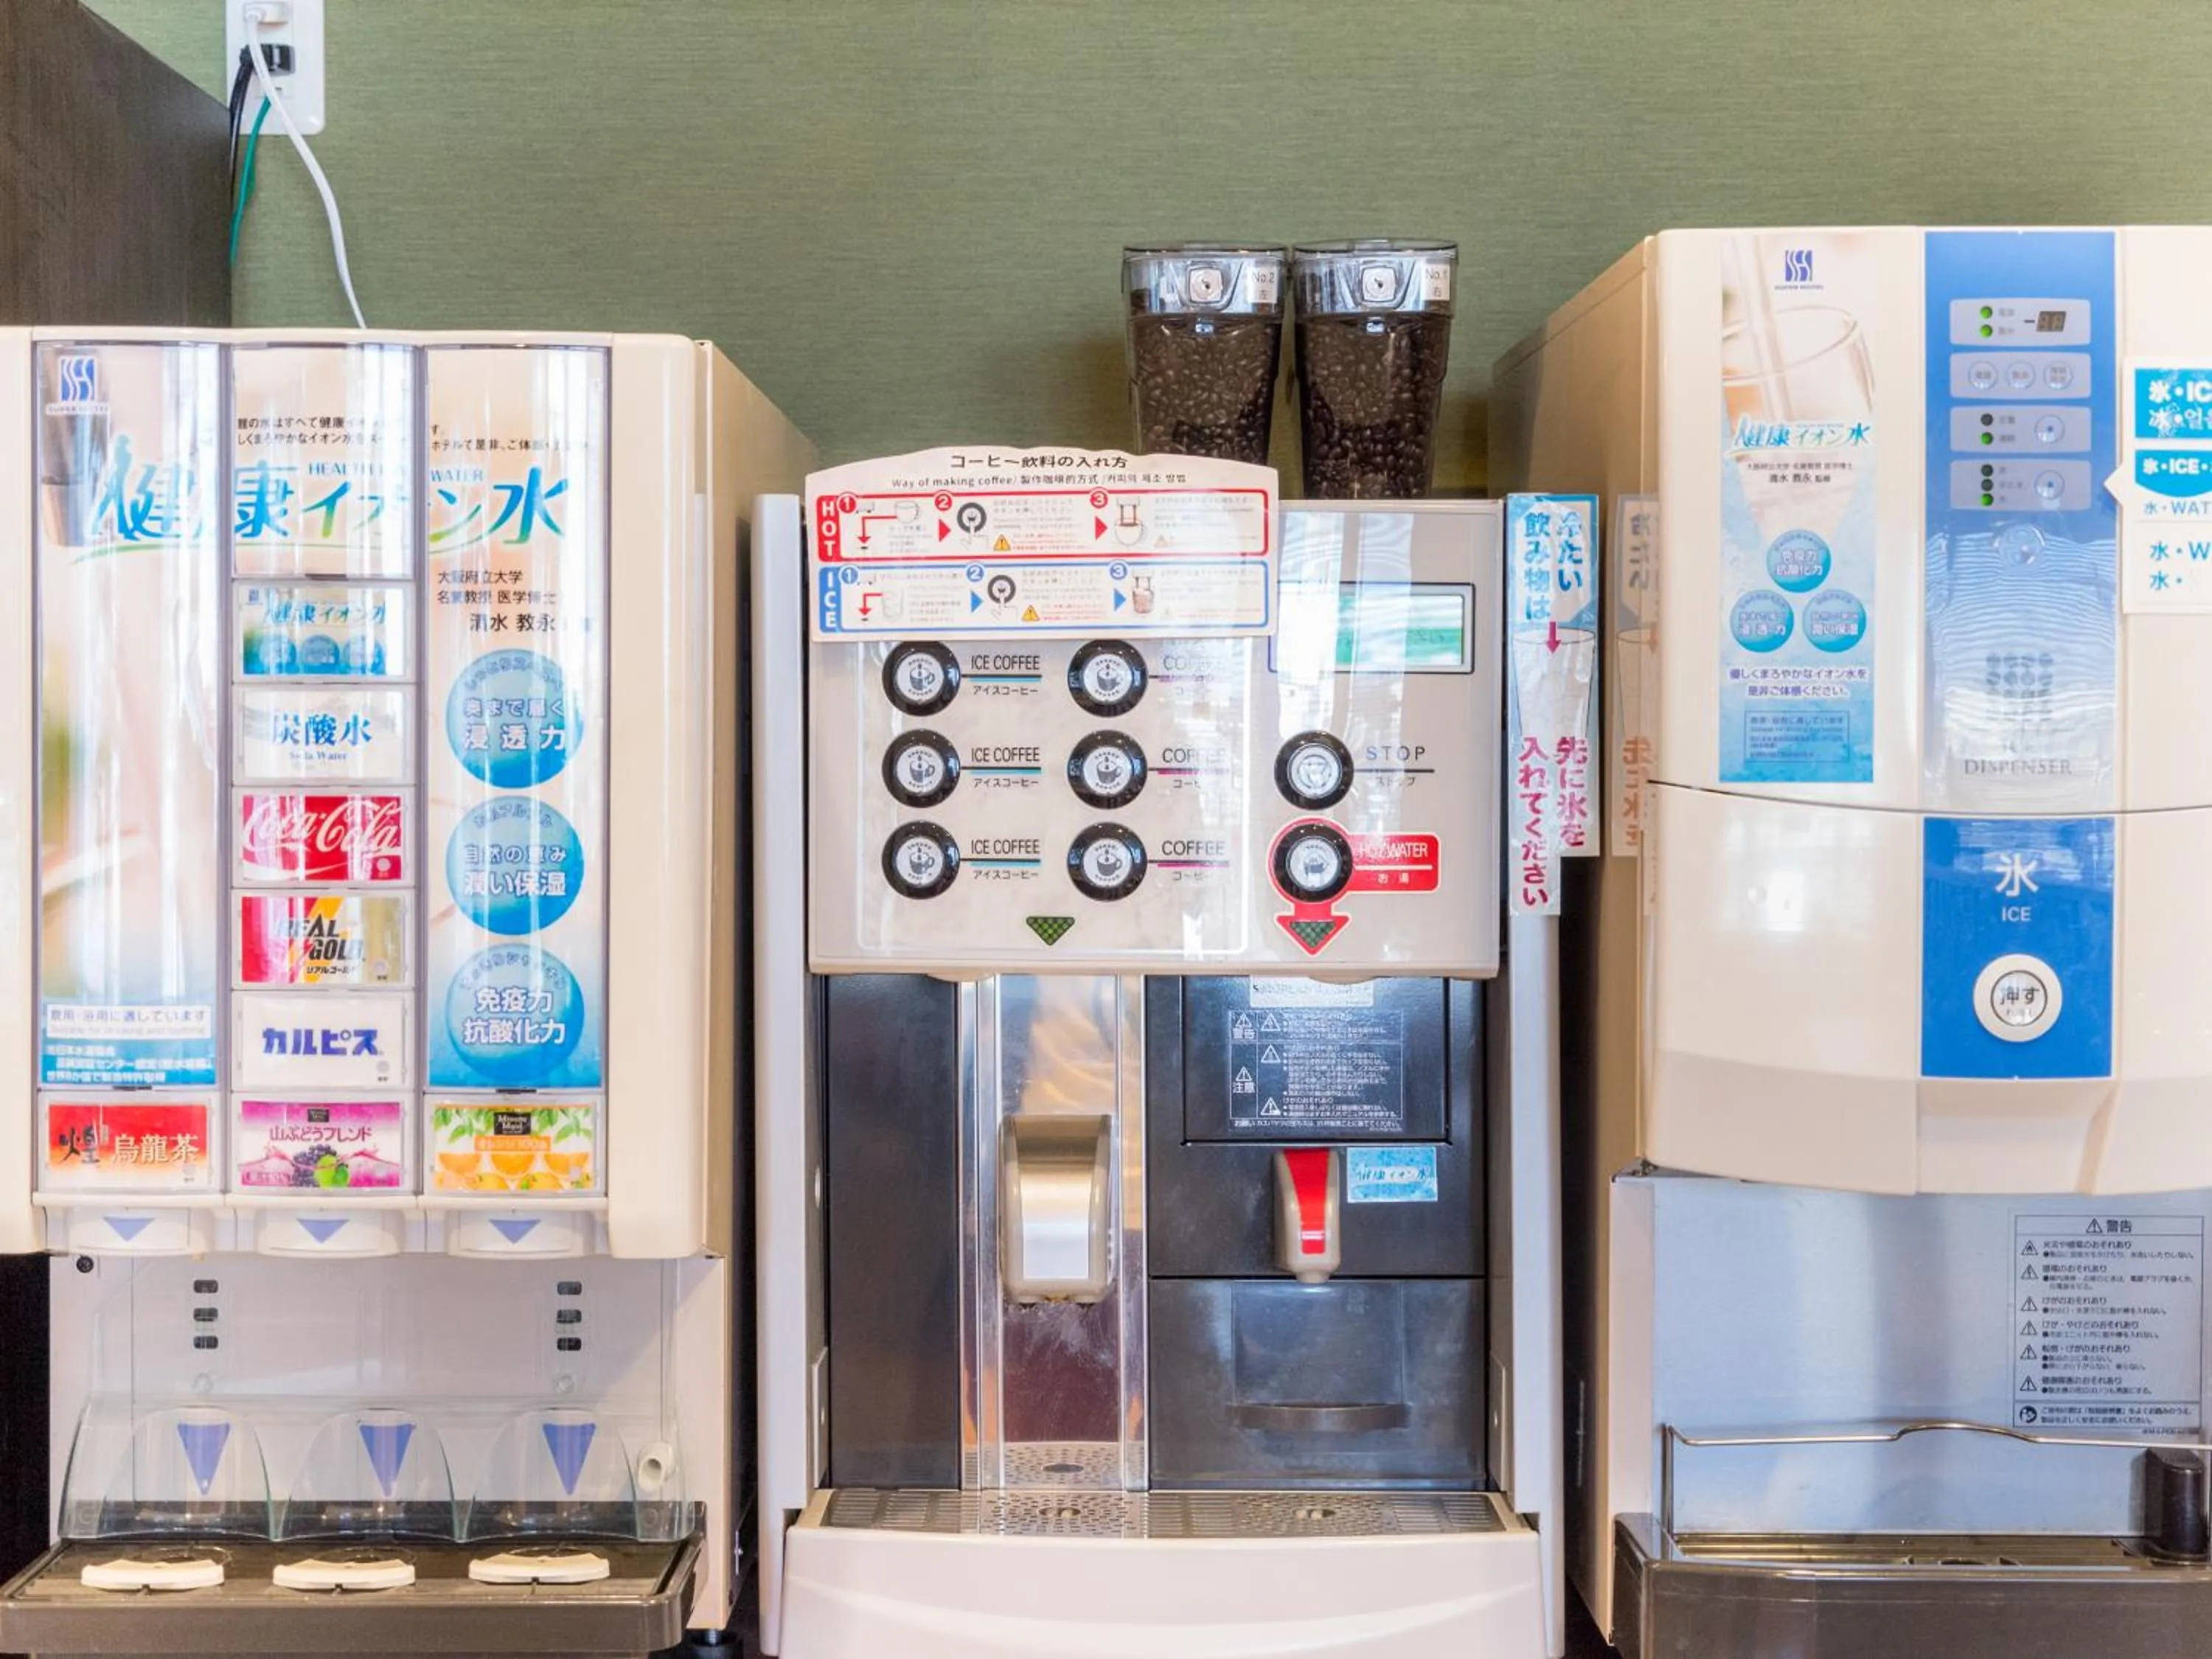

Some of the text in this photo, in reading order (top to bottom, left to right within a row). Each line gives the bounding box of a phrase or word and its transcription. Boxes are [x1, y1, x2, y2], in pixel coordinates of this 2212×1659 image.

[950, 454, 1128, 468] コーヒー飲料の入れ方
[891, 478, 914, 489] Way
[918, 477, 929, 487] of
[932, 476, 975, 488] making
[821, 501, 838, 557] HOT
[1557, 511, 1584, 592] 冷たい
[1523, 512, 1551, 621] 飲み物は
[824, 571, 837, 627] ICE
[971, 654, 1040, 670] ICE COFFEE
[973, 685, 1039, 695] アイスコーヒー
[273, 712, 374, 747] 炭酸水
[317, 751, 347, 761] Water
[971, 747, 1040, 762] ICE COFFEE
[1366, 745, 1426, 760] STOP
[1964, 759, 2073, 775] DISPENSER
[973, 778, 1039, 788] アイスコーヒー
[1556, 736, 1588, 848] 先に氷を
[1518, 736, 1549, 907] 入れてください
[971, 839, 1040, 855] ICE COFFEE
[1161, 841, 1225, 855] COFFEE
[973, 870, 1039, 880] アイスコーヒー
[1994, 853, 2039, 897] 氷
[2001, 906, 2032, 922] ICE
[475, 985, 553, 1014] 免疫力
[1999, 986, 2040, 1006] 押す
[462, 1018, 567, 1046] 抗酸化力
[262, 1027, 379, 1056] カルピス
[1232, 1082, 1256, 1093] 注意
[2106, 1219, 2132, 1234] 警告
